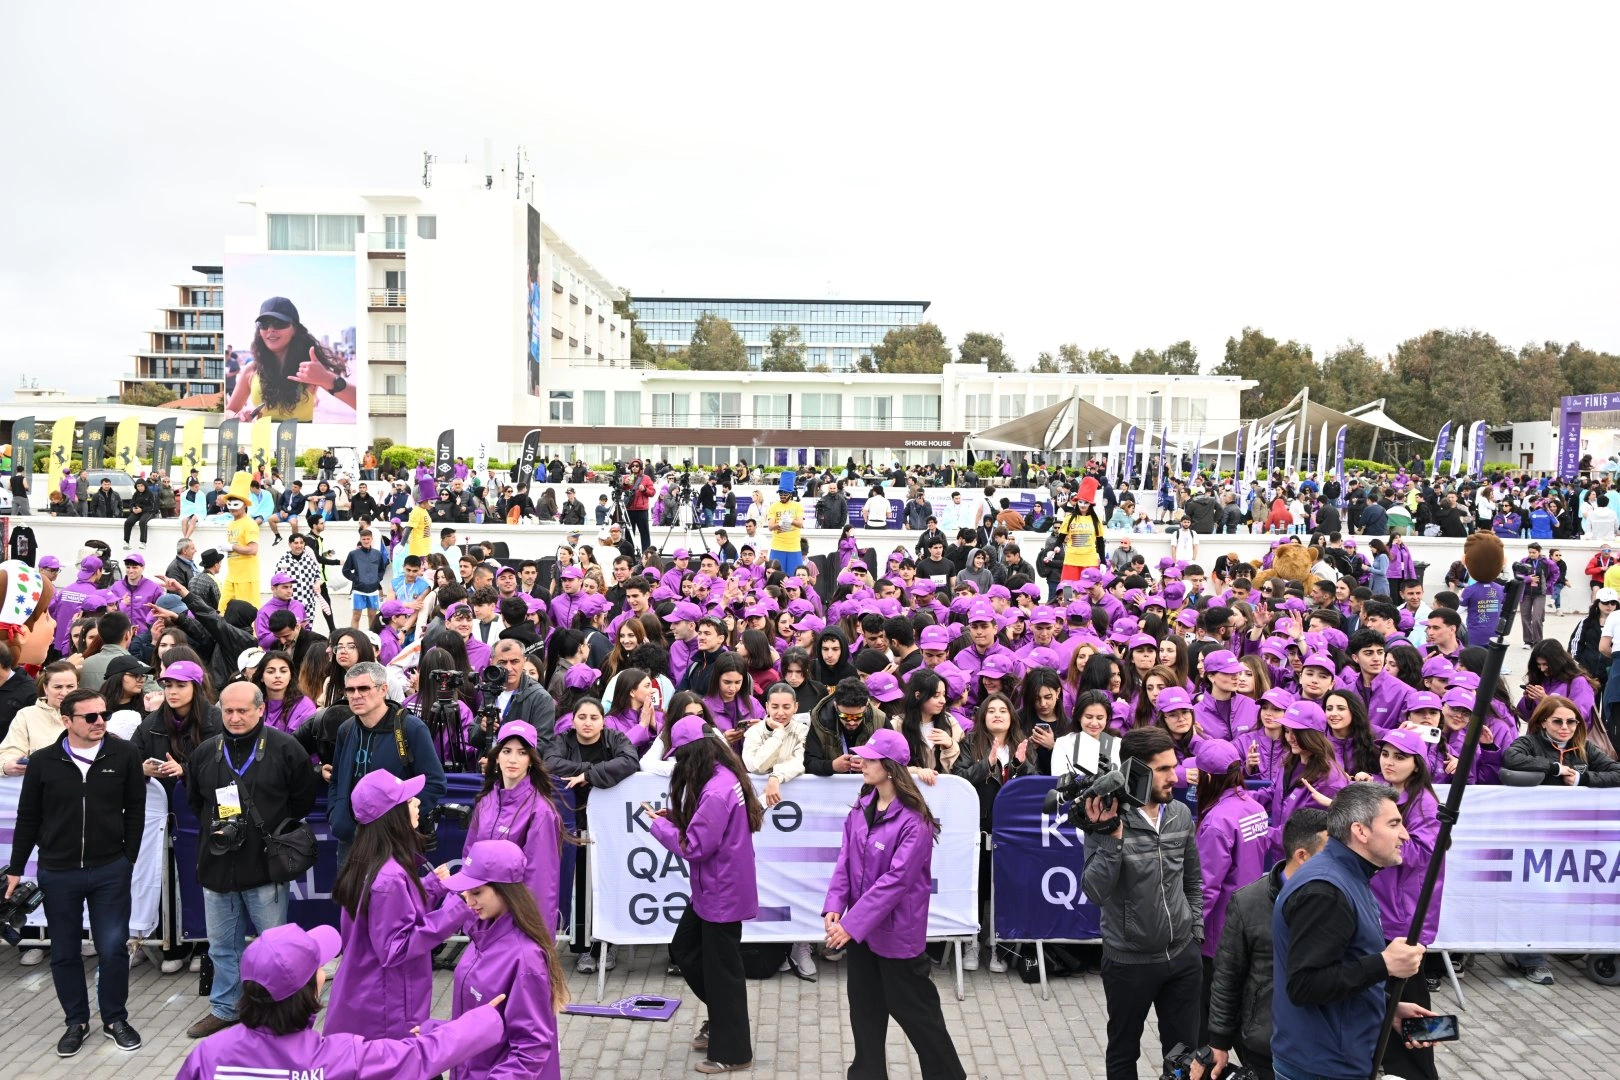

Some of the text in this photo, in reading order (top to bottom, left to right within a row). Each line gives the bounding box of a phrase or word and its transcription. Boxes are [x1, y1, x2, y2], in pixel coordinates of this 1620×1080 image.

[1585, 394, 1608, 409] FİNİŞ
[439, 443, 450, 460] bir
[524, 444, 535, 462] bir
[628, 891, 691, 926] GƏ
[291, 1067, 324, 1080] BAKI
